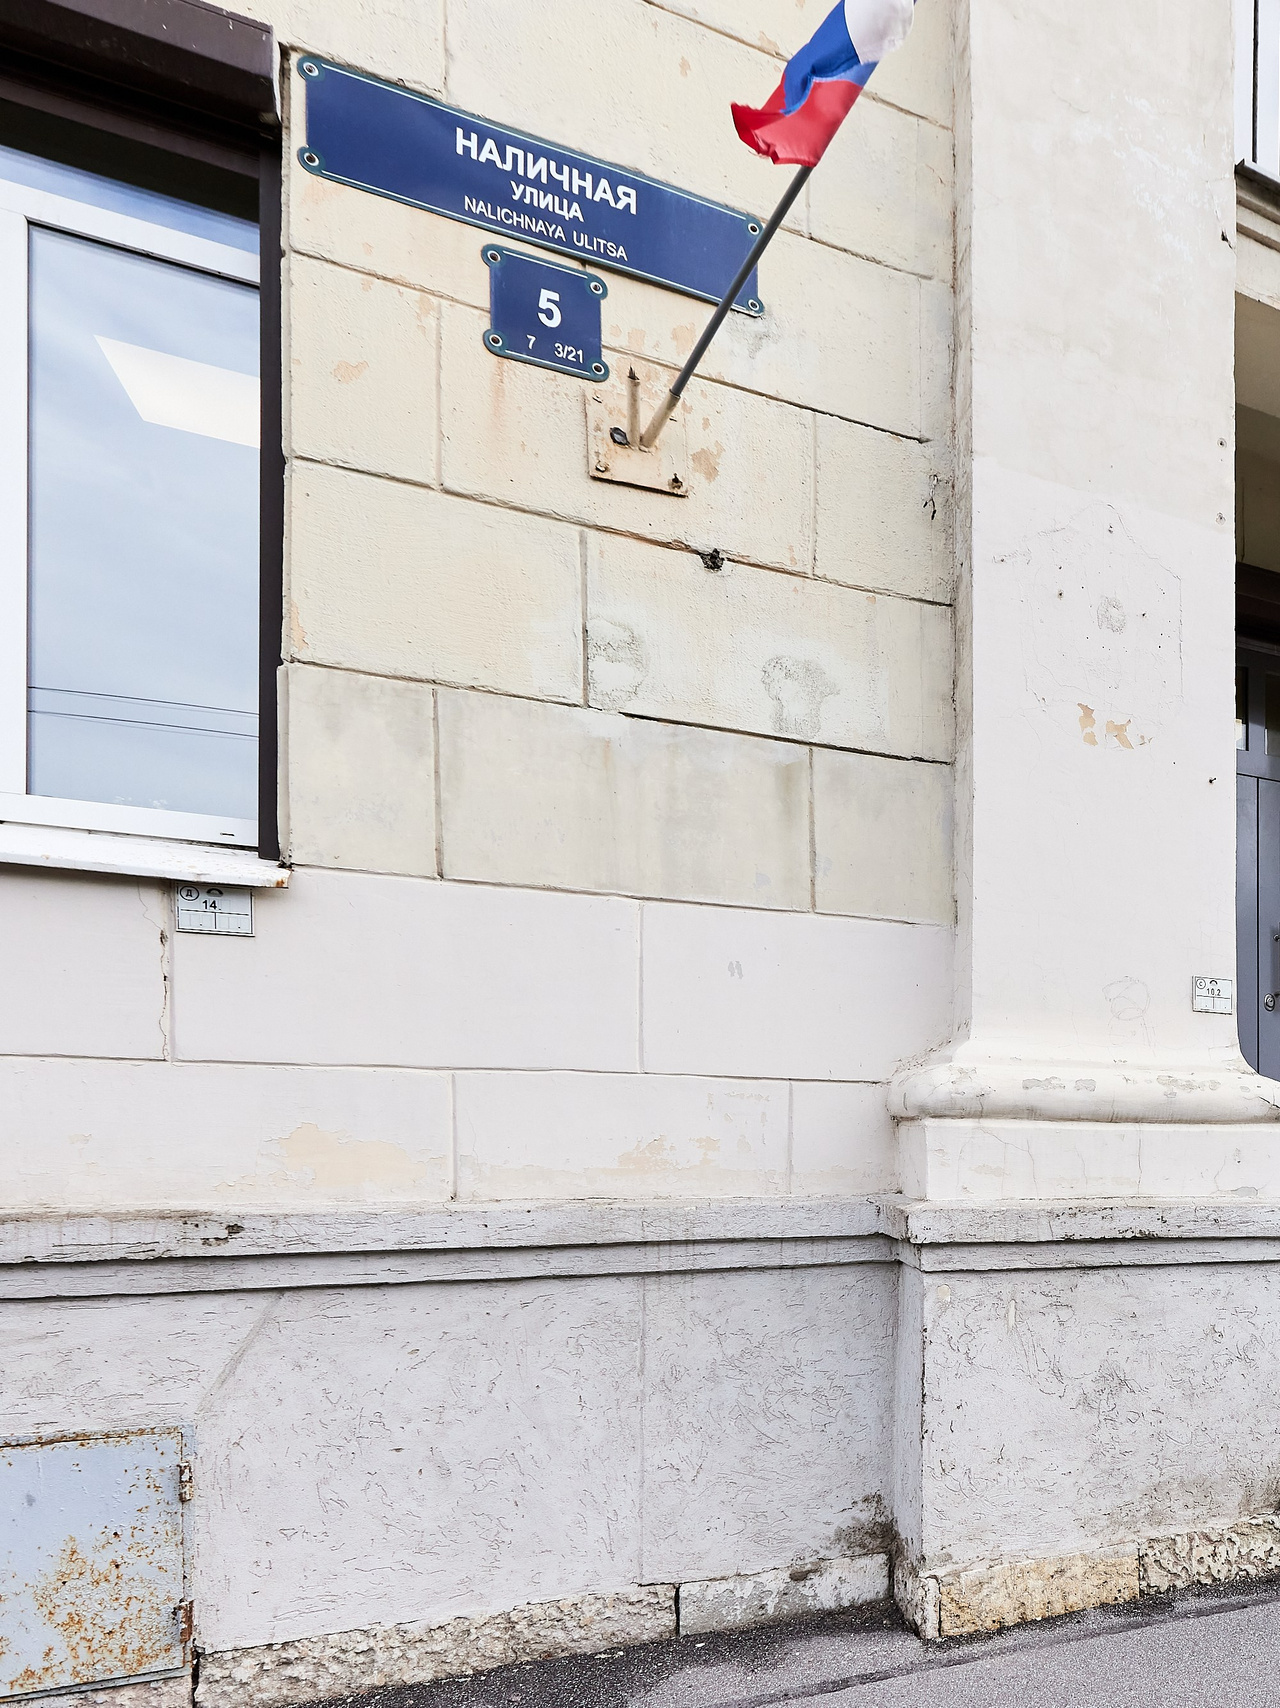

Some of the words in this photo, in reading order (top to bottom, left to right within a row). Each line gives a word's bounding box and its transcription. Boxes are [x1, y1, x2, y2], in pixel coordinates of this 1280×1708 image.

[456, 127, 637, 215] НАЛИЧНАЯ
[510, 180, 584, 222] УЛИЦА
[464, 195, 566, 241] NALICHNAYA
[573, 231, 628, 261] ULITSA
[537, 288, 562, 328] 5
[526, 334, 536, 349] 7
[554, 342, 583, 363] 3/21
